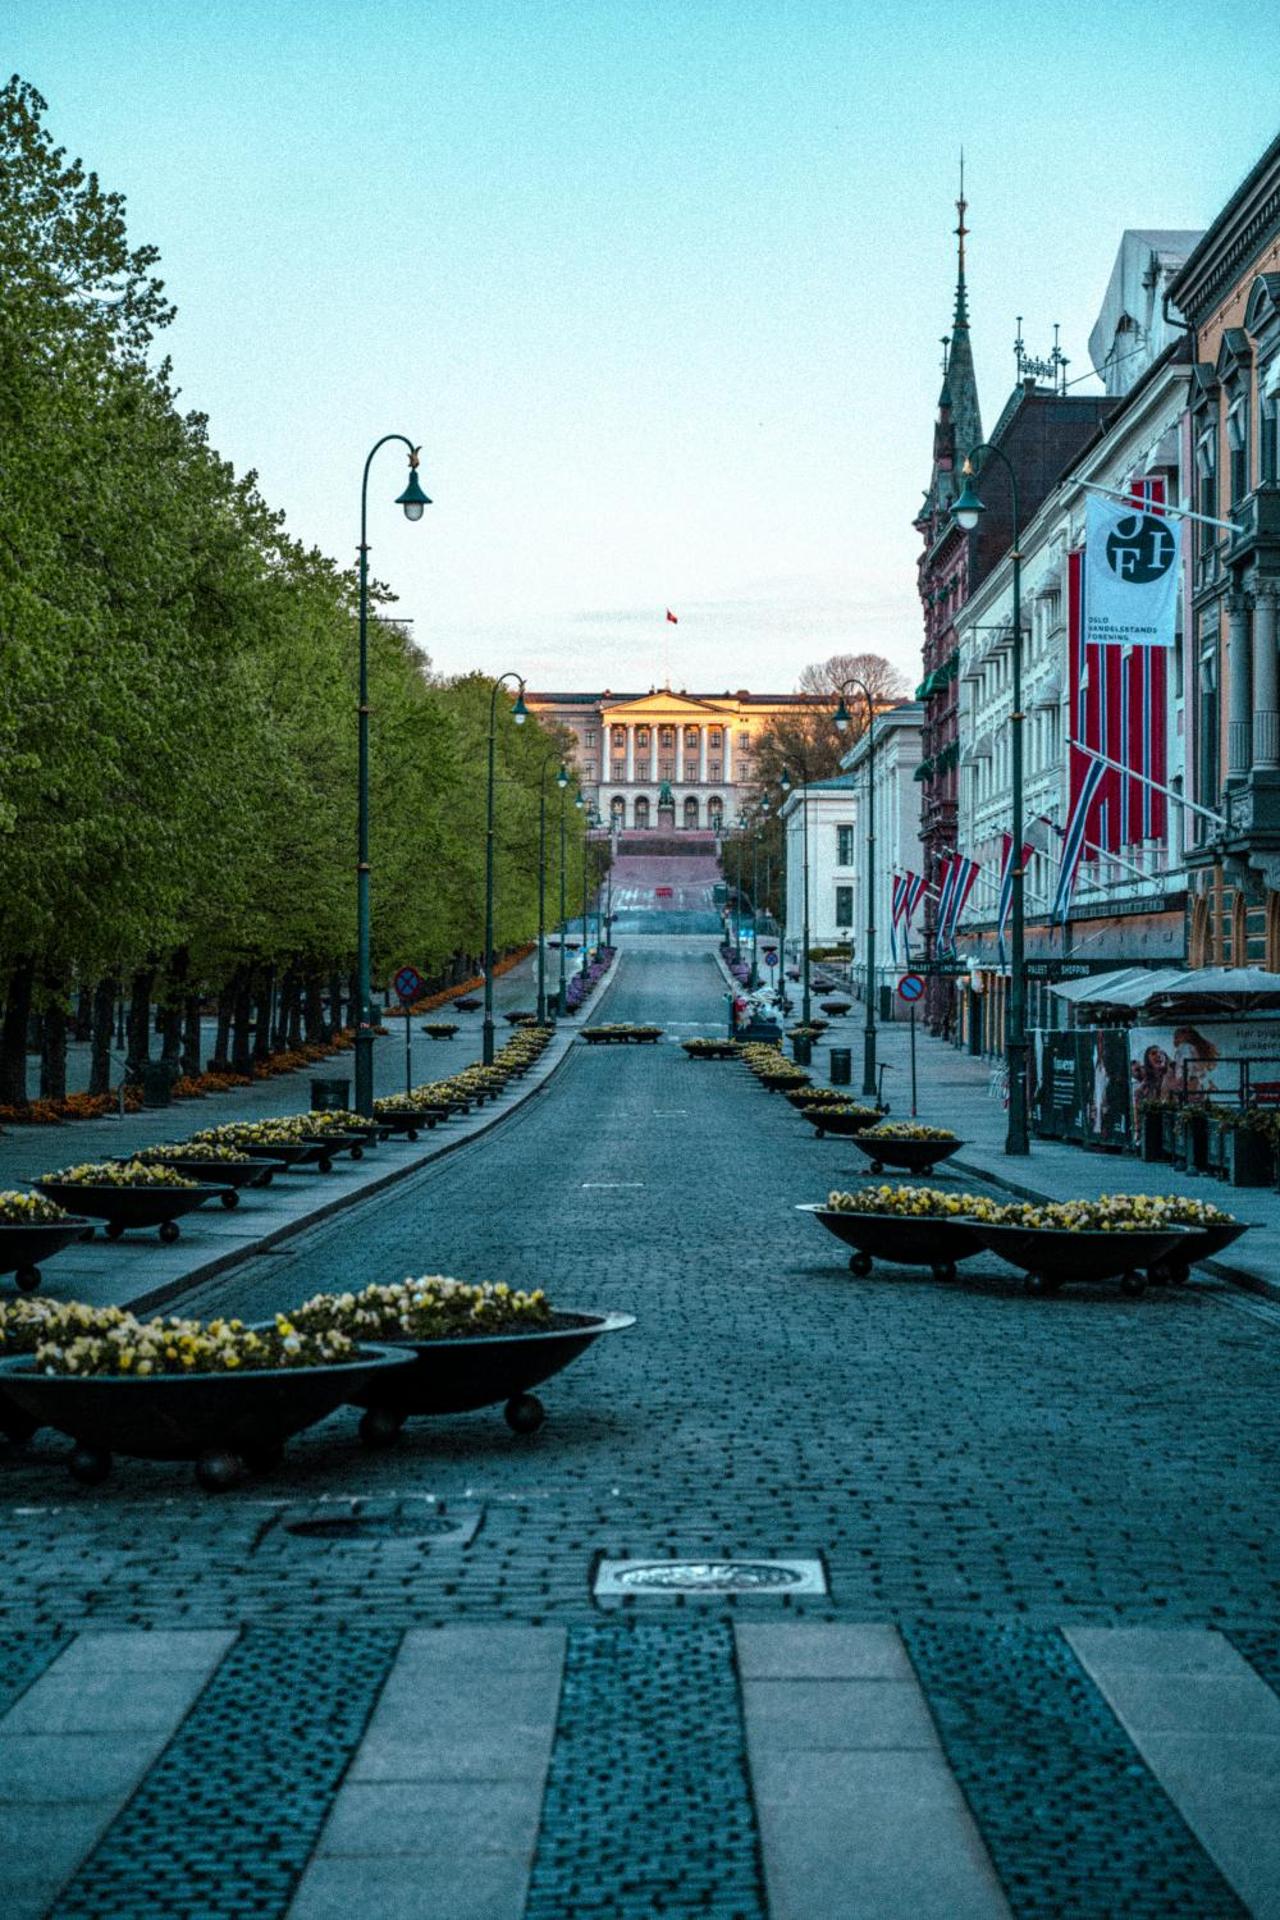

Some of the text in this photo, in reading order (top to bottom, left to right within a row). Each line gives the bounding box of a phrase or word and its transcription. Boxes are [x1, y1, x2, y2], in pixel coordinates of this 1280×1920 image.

[1088, 616, 1109, 624] OSLO
[1087, 633, 1130, 641] FORENING
[1061, 964, 1090, 975] SHOPPING
